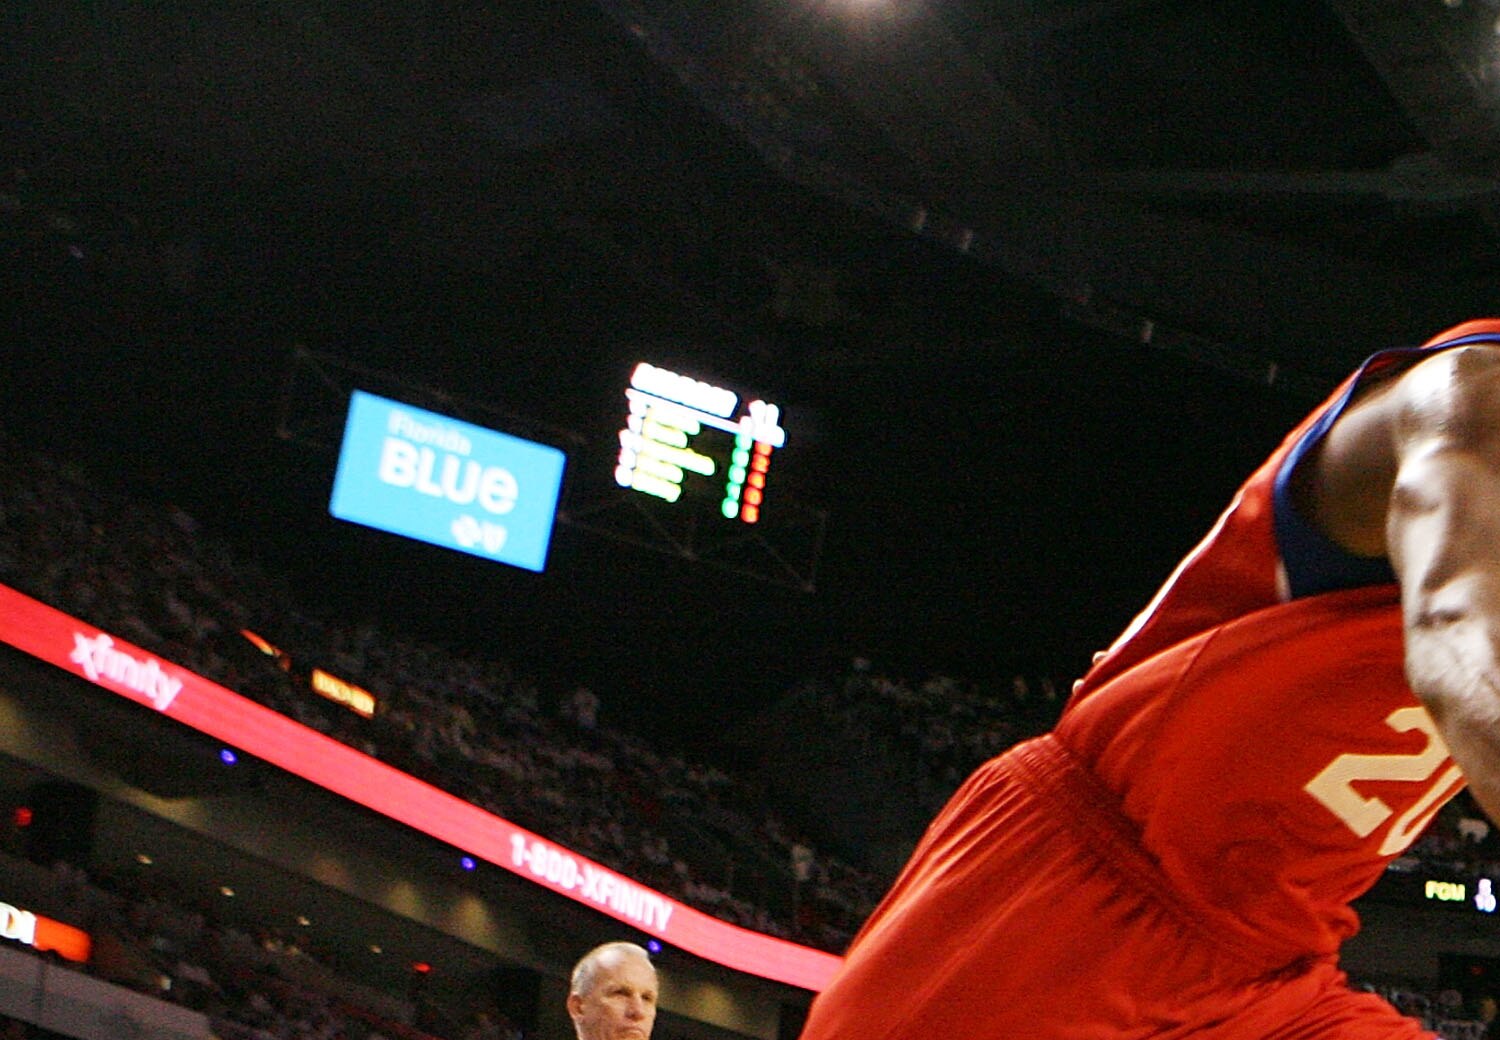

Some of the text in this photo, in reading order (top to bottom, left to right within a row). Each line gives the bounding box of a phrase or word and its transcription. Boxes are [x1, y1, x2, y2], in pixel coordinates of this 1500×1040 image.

[70, 632, 183, 711] xfinity
[510, 833, 673, 931] 1-800-XFINITY
[1425, 880, 1465, 901] FGM
